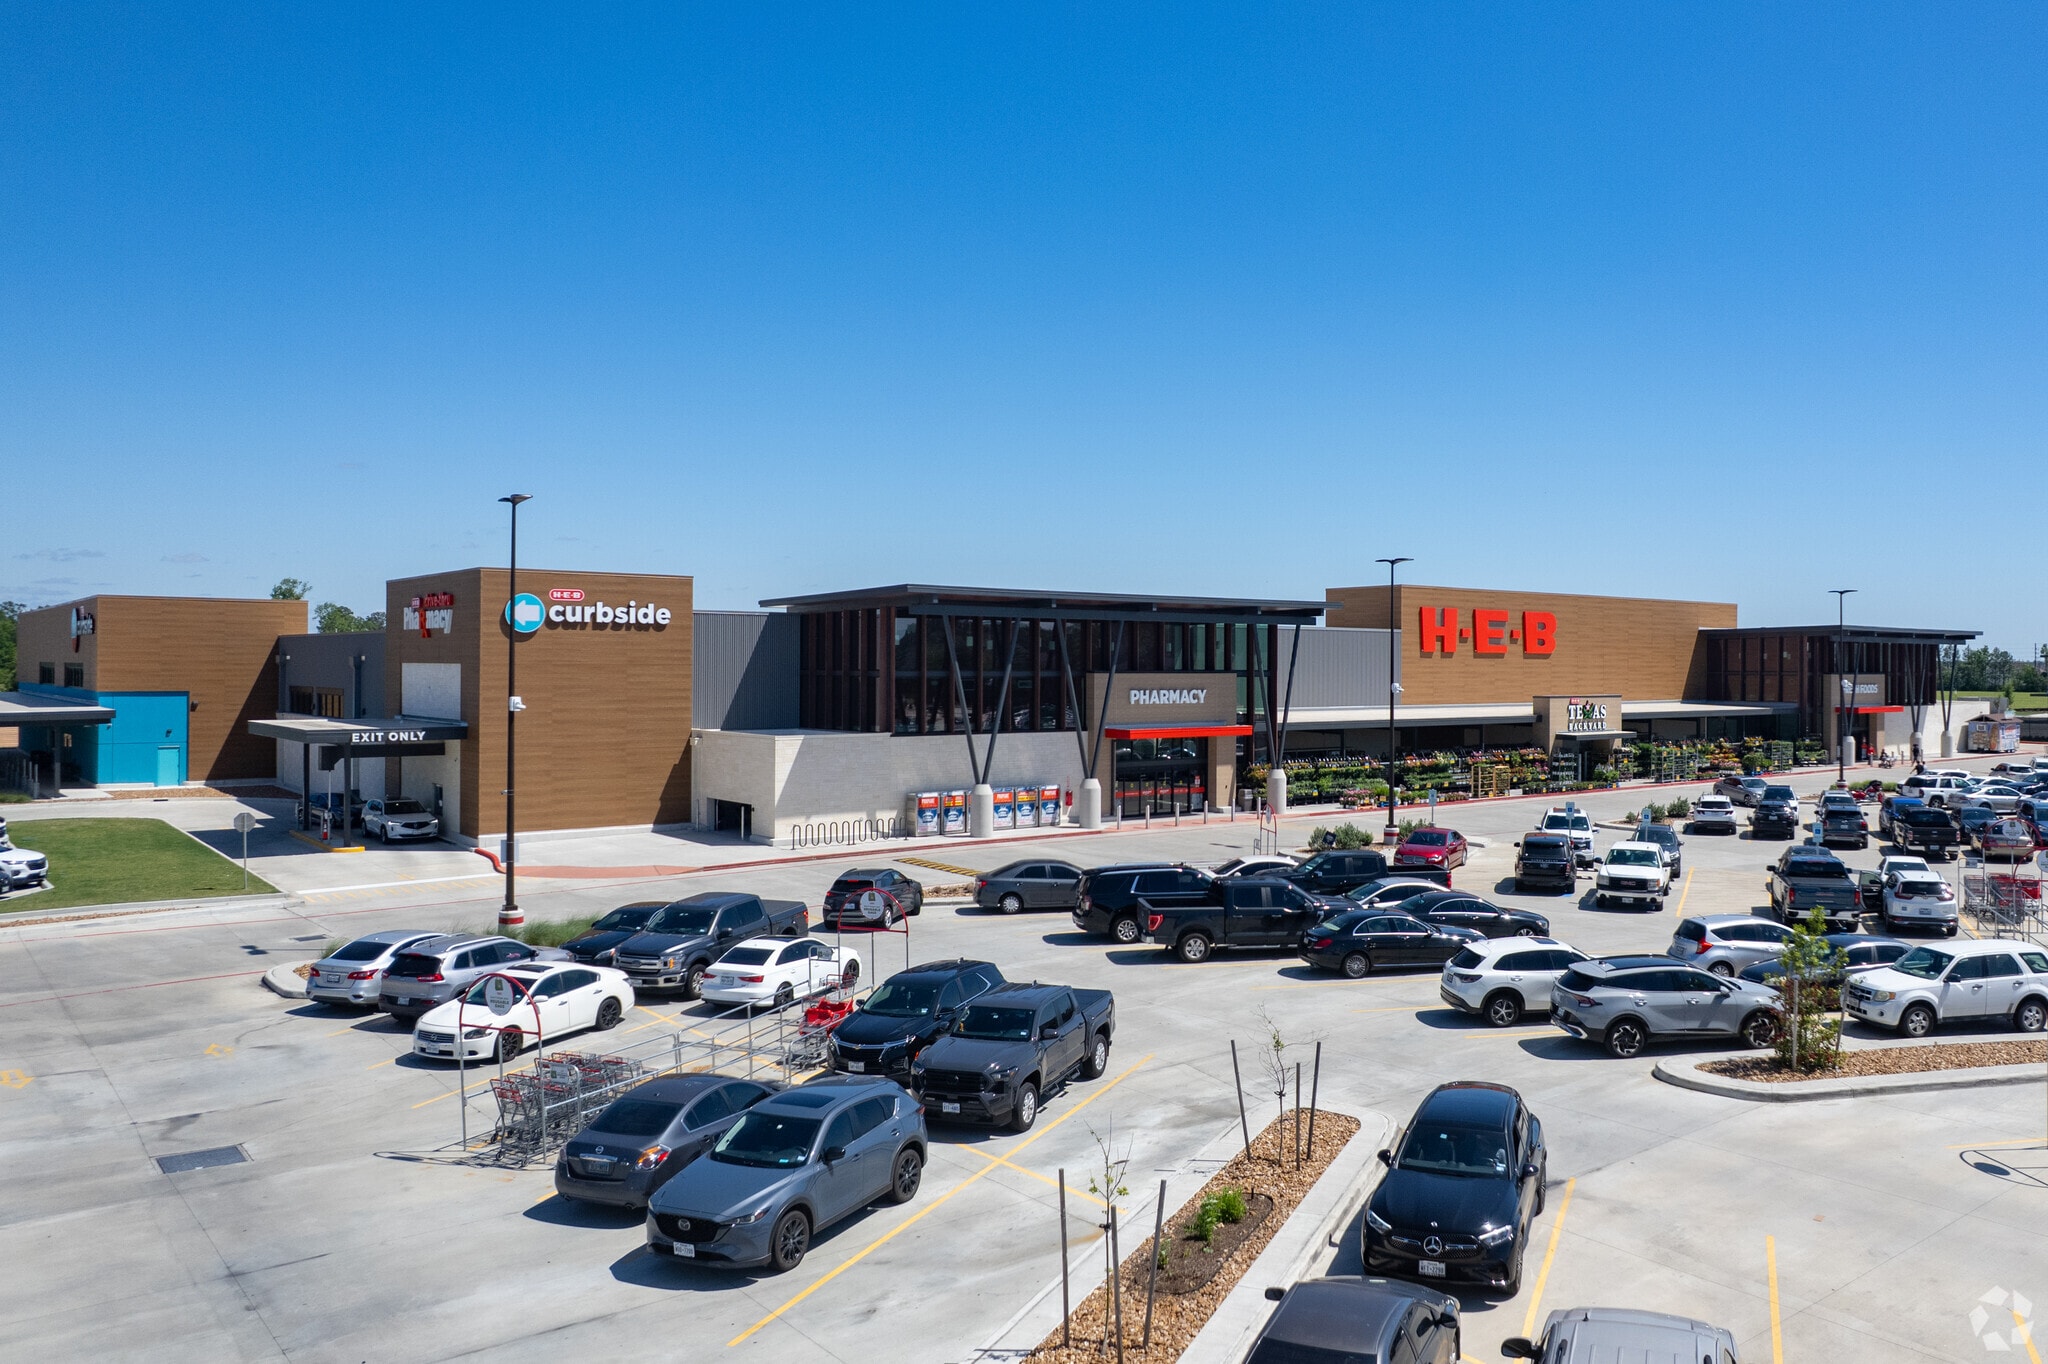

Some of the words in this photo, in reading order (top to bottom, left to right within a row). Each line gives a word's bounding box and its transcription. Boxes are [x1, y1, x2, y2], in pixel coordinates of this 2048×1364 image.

[549, 600, 671, 624] curbside
[1129, 689, 1207, 704] PHARMACY
[1568, 703, 1607, 719] TEXAS
[1568, 721, 1607, 731] BACKYARD
[351, 732, 384, 742] EXIT
[388, 731, 426, 741] ONLY
